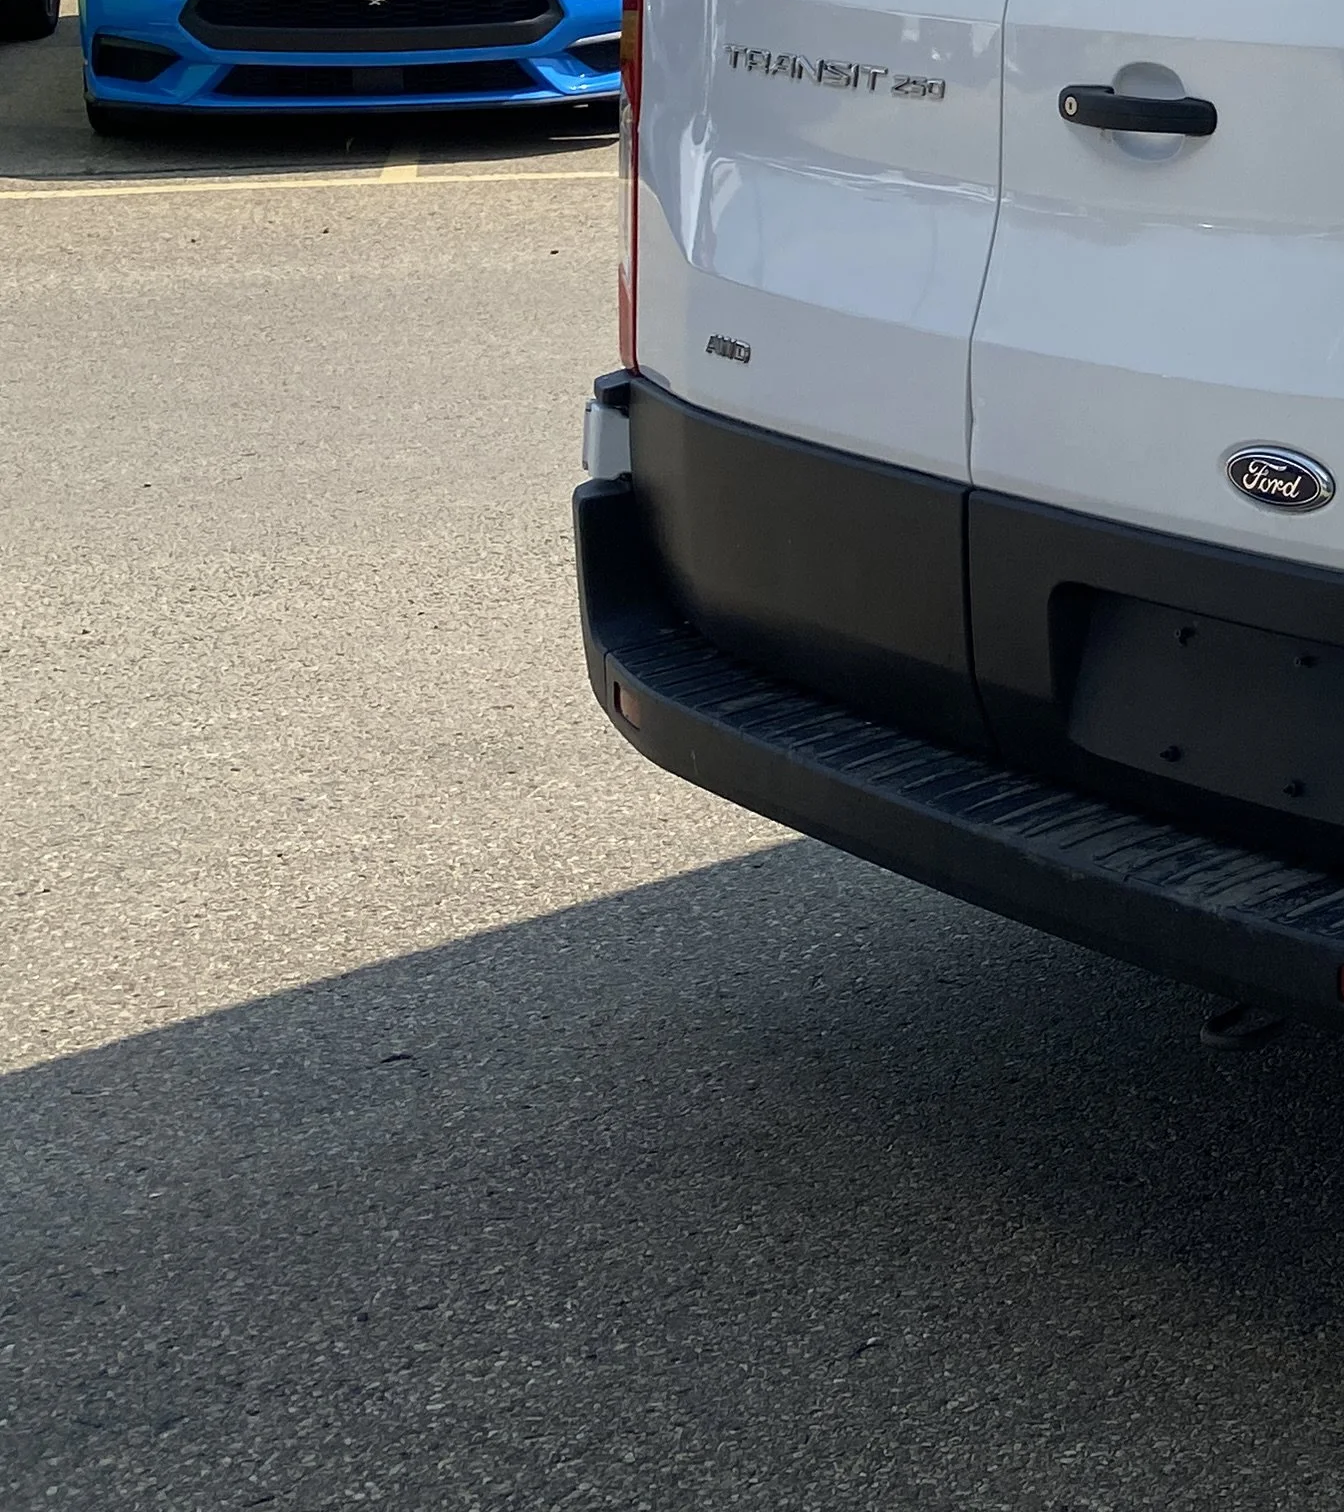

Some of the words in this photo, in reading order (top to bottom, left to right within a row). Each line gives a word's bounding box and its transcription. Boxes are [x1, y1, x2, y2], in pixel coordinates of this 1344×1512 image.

[723, 42, 889, 91] TRANSIT
[892, 74, 946, 99] 250
[706, 334, 751, 363] AWD
[1243, 459, 1301, 498] Ford
